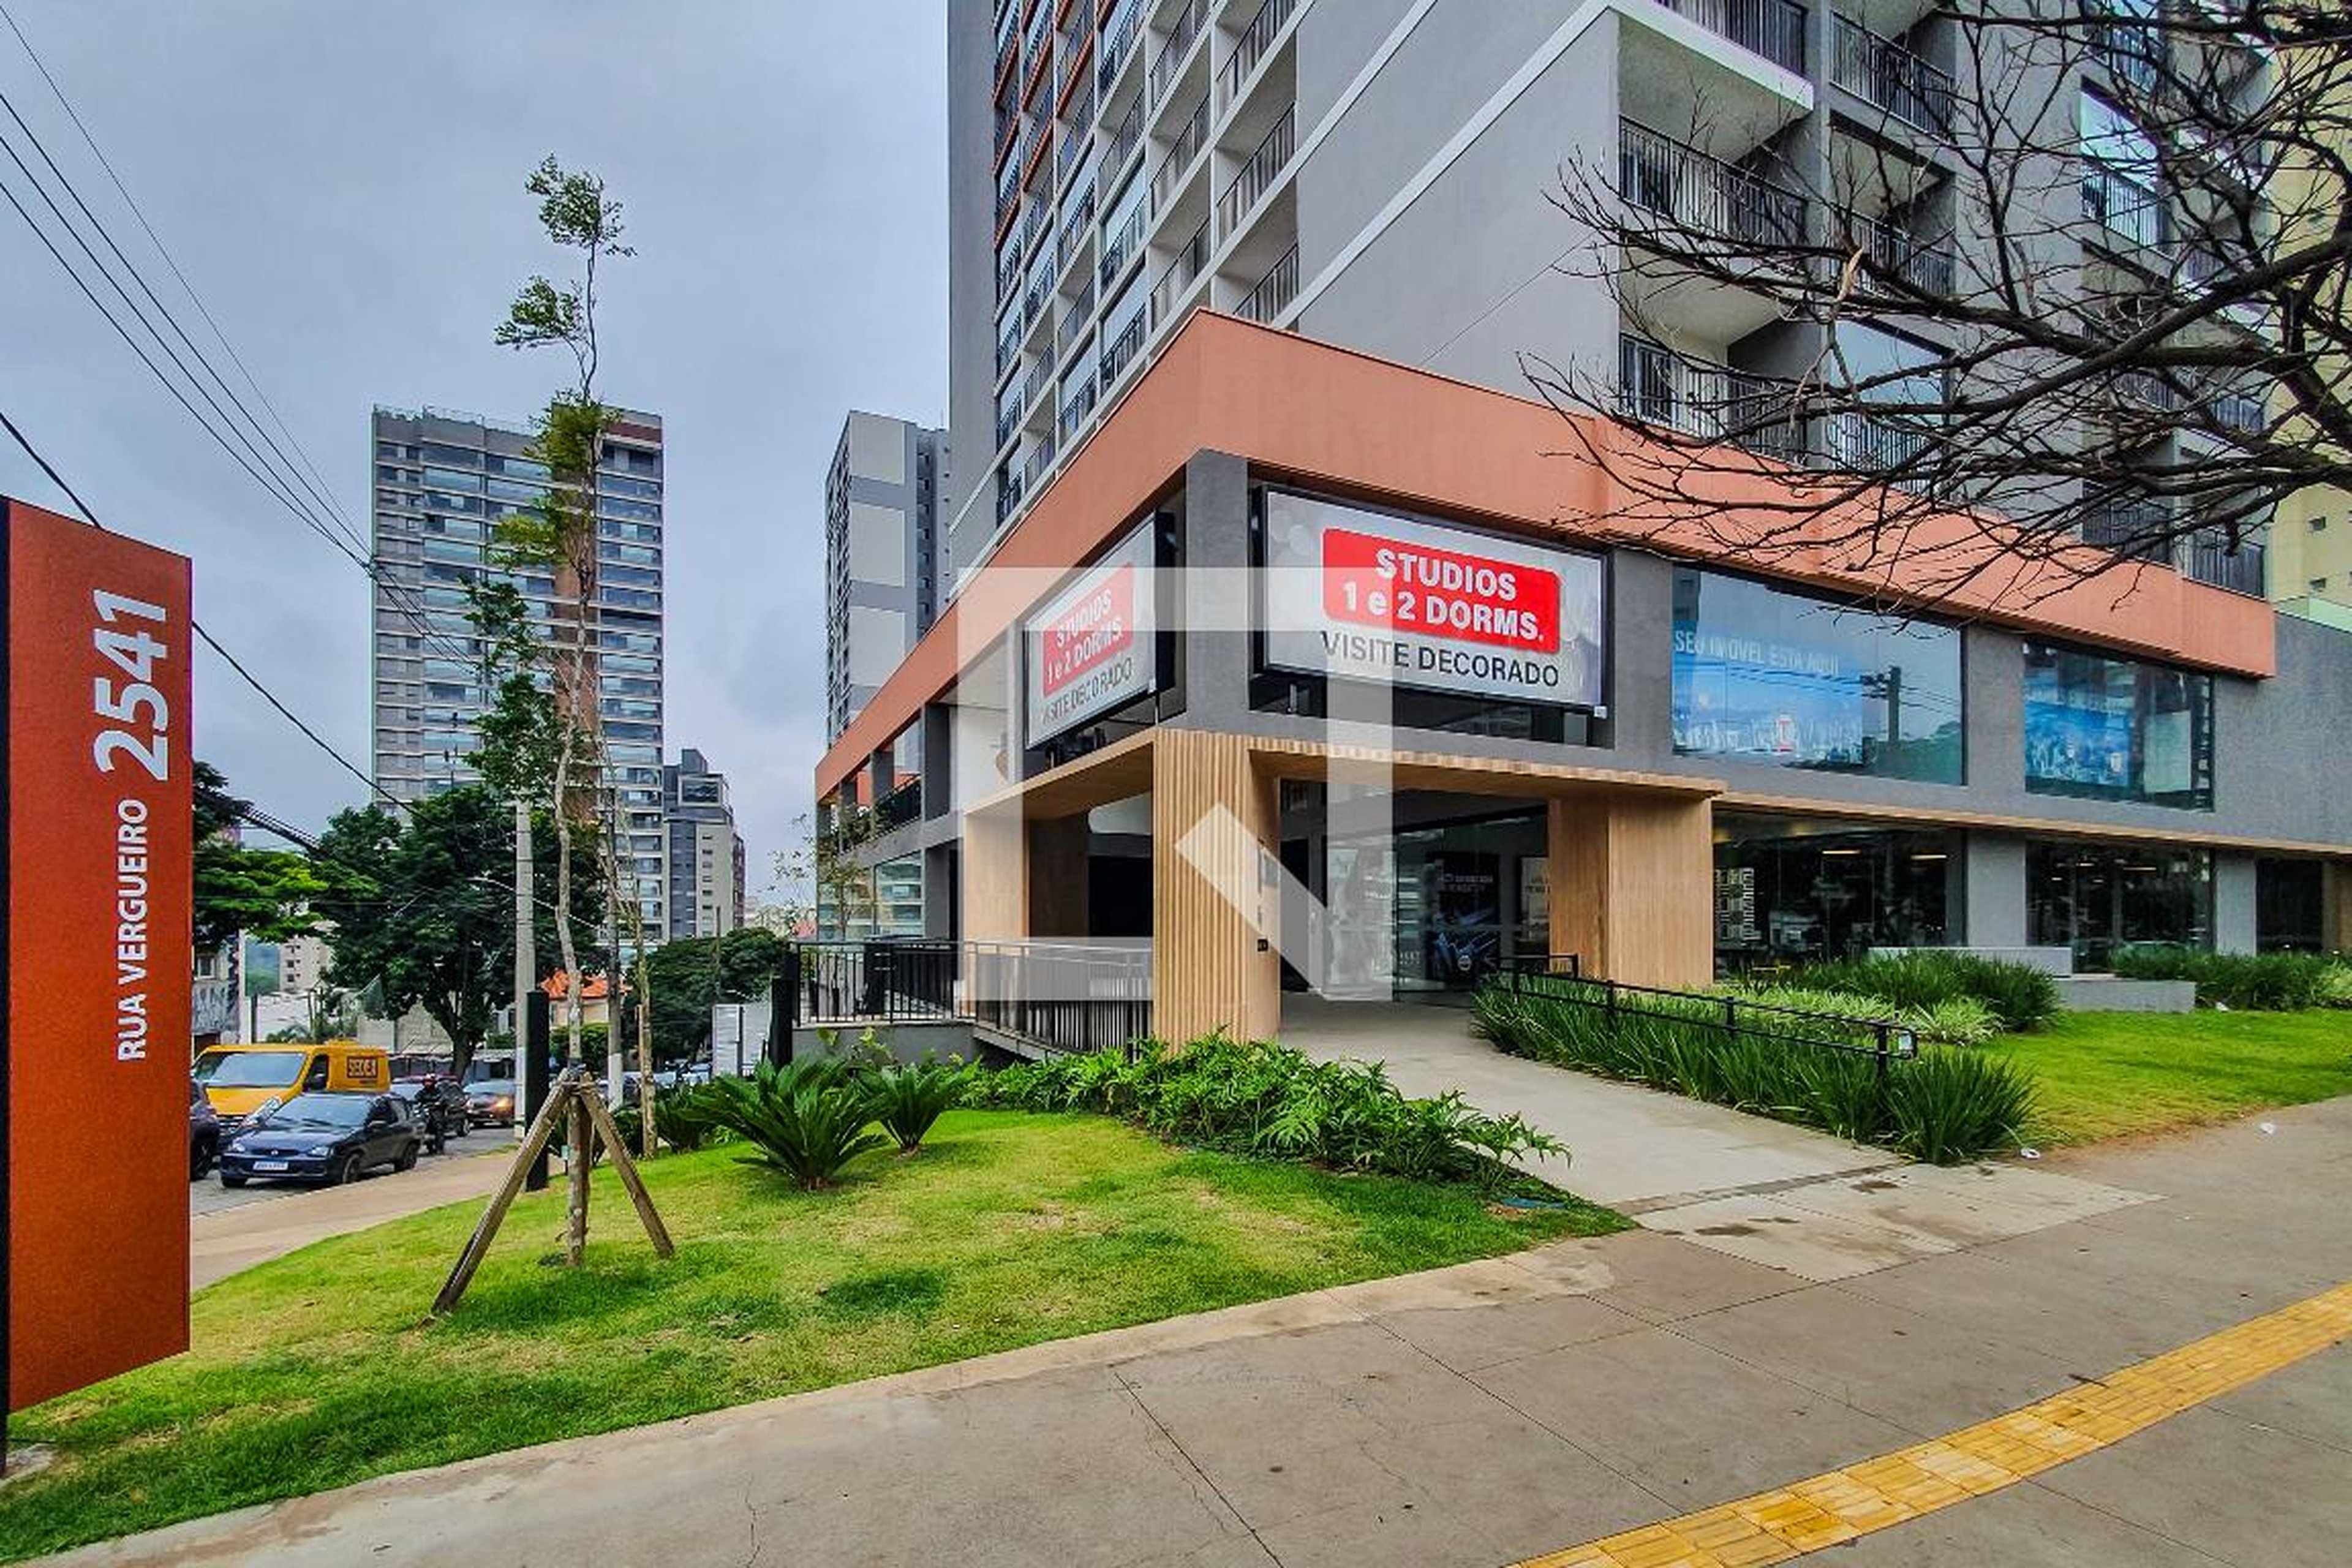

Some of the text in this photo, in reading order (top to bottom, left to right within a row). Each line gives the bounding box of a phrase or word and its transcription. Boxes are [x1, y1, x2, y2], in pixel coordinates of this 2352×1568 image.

[1376, 548, 1517, 601] STUDIOS
[1343, 581, 1545, 641] 1 e 2 DORMS.
[1321, 630, 1559, 687] VISITE DECORADO
[1675, 630, 1705, 654] SEU
[92, 588, 168, 1061] RUA VERGUEIRO 2541
